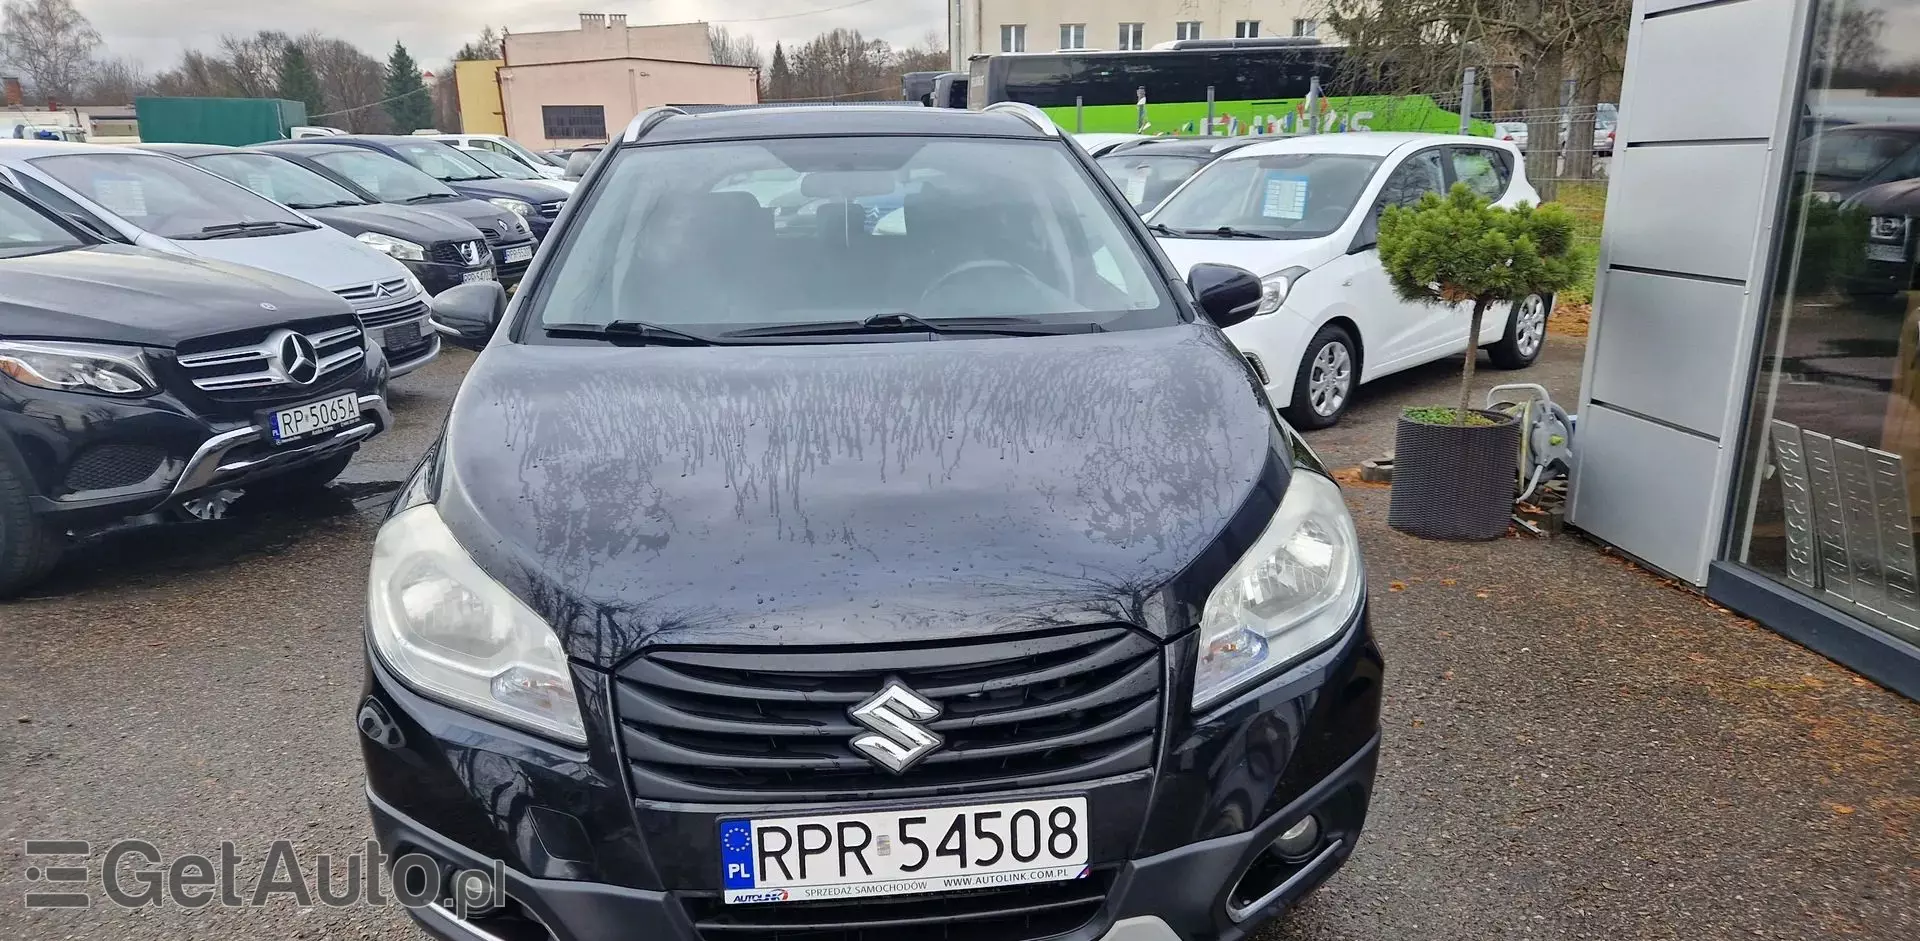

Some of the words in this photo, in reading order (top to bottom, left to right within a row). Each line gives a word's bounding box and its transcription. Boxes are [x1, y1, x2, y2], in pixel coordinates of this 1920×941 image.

[281, 410, 304, 436] RP
[309, 396, 357, 428] 5065A
[757, 820, 873, 882] RPR
[898, 805, 1079, 873] 54508
[728, 863, 751, 879] PL
[943, 868, 1069, 888] WWW.AUTOLINK.COM.PL
[804, 884, 852, 897] SPRZEDAŻ
[854, 881, 928, 896] SAMOCHODÓW
